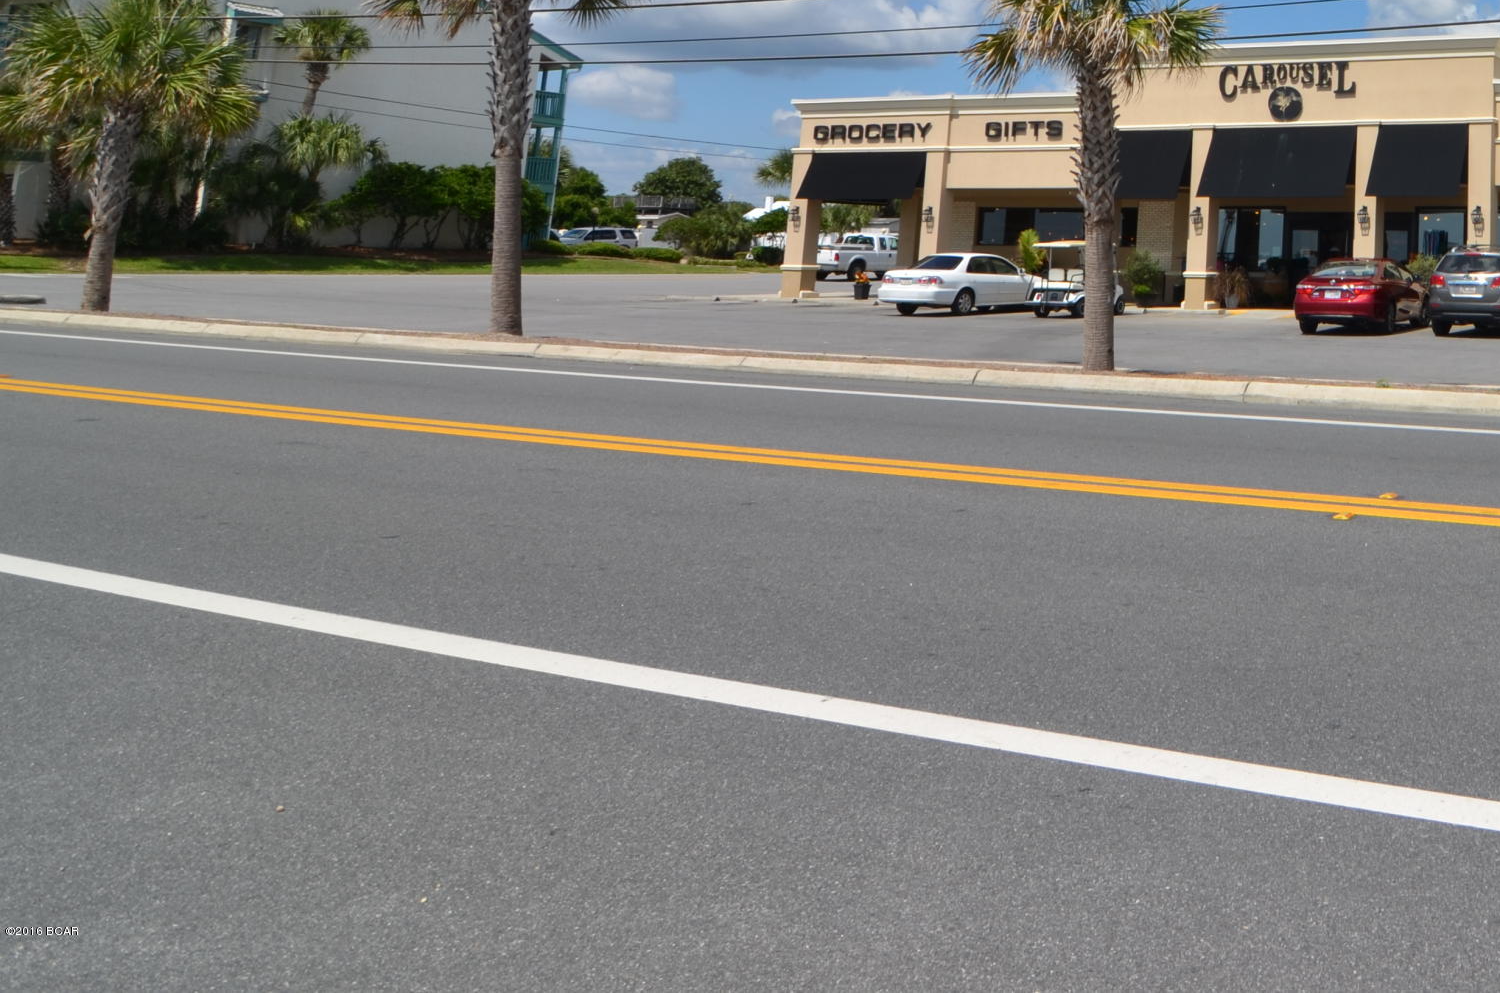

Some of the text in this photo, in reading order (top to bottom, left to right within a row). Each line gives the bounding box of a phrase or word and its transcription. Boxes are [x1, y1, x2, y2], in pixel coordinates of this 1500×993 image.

[1219, 62, 1356, 99] CAROUSEL
[813, 122, 932, 141] GROCERY
[985, 120, 1063, 138] GIFTS
